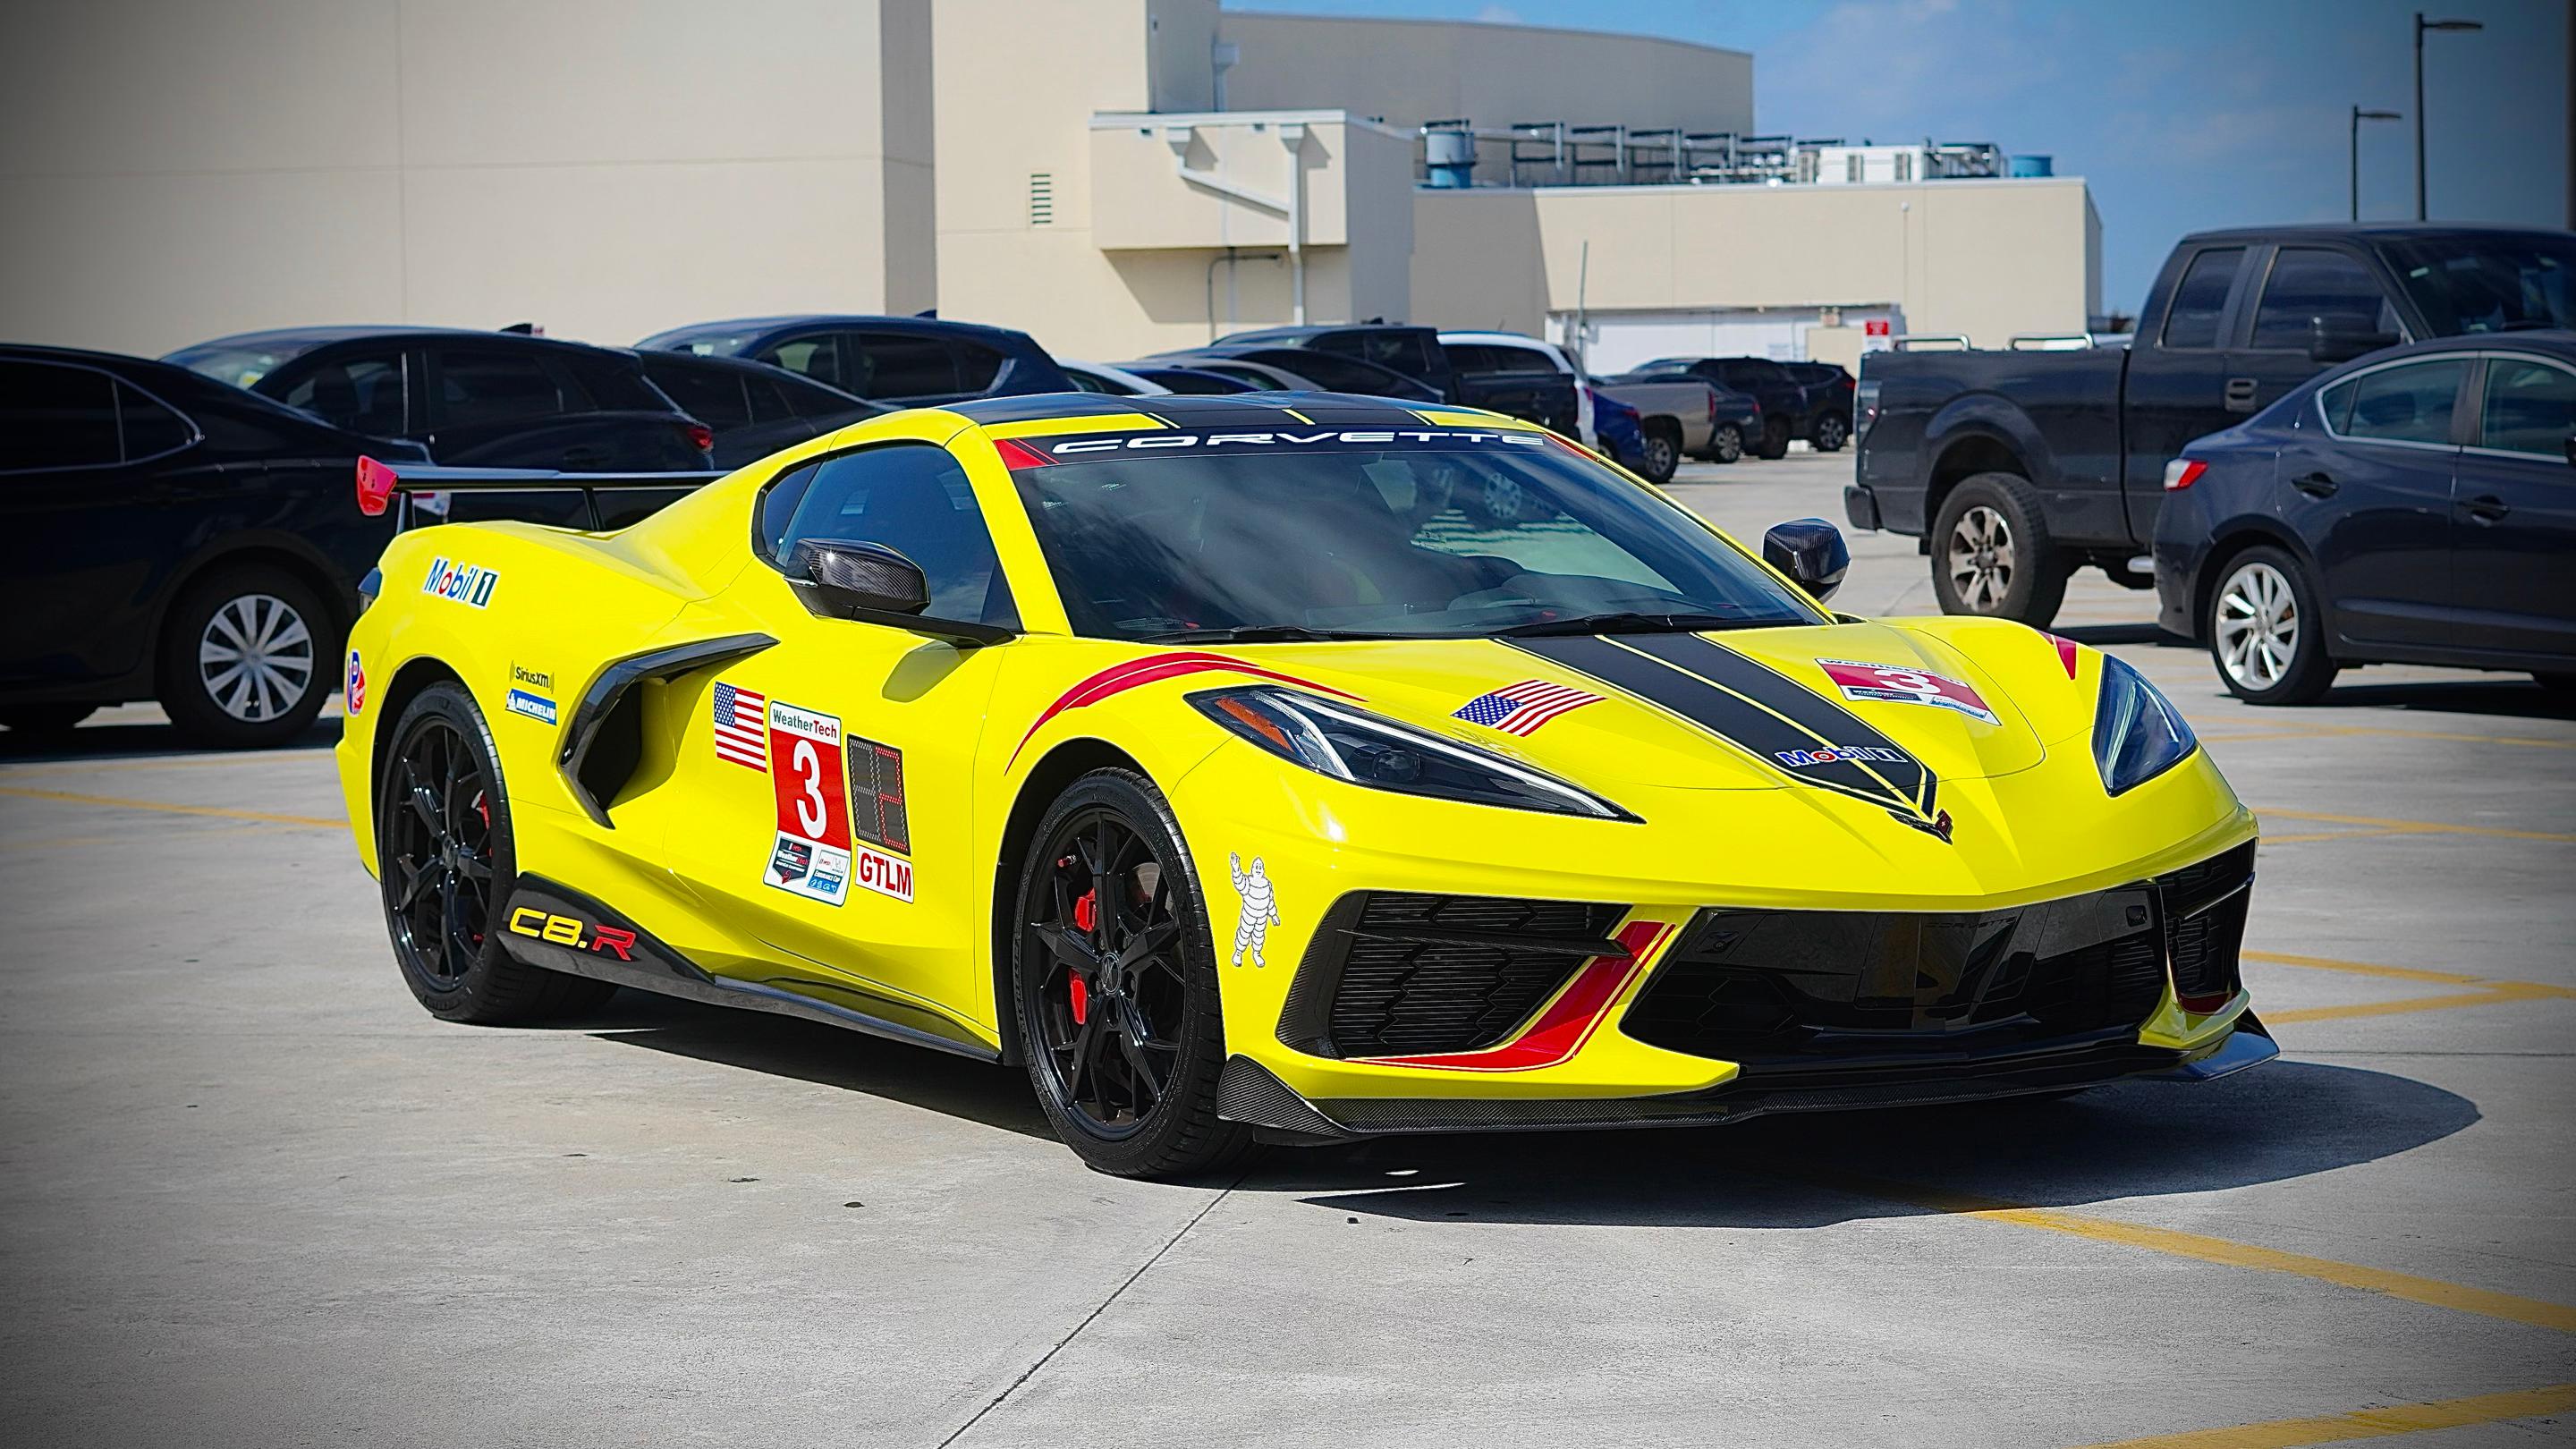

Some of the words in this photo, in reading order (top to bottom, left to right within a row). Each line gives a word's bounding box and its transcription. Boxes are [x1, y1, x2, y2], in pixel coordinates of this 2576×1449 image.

[1051, 431, 1544, 454] CORVETTE
[424, 559, 479, 601] Mobil
[473, 572, 496, 606] 1
[1874, 669, 1941, 694] 3
[516, 697, 555, 720] MICHELIN
[773, 708, 837, 739] WeatherTech
[1775, 746, 1877, 767] Mobil
[792, 739, 827, 840] 3
[860, 852, 912, 897] GTLM
[510, 907, 637, 962] C8.R
